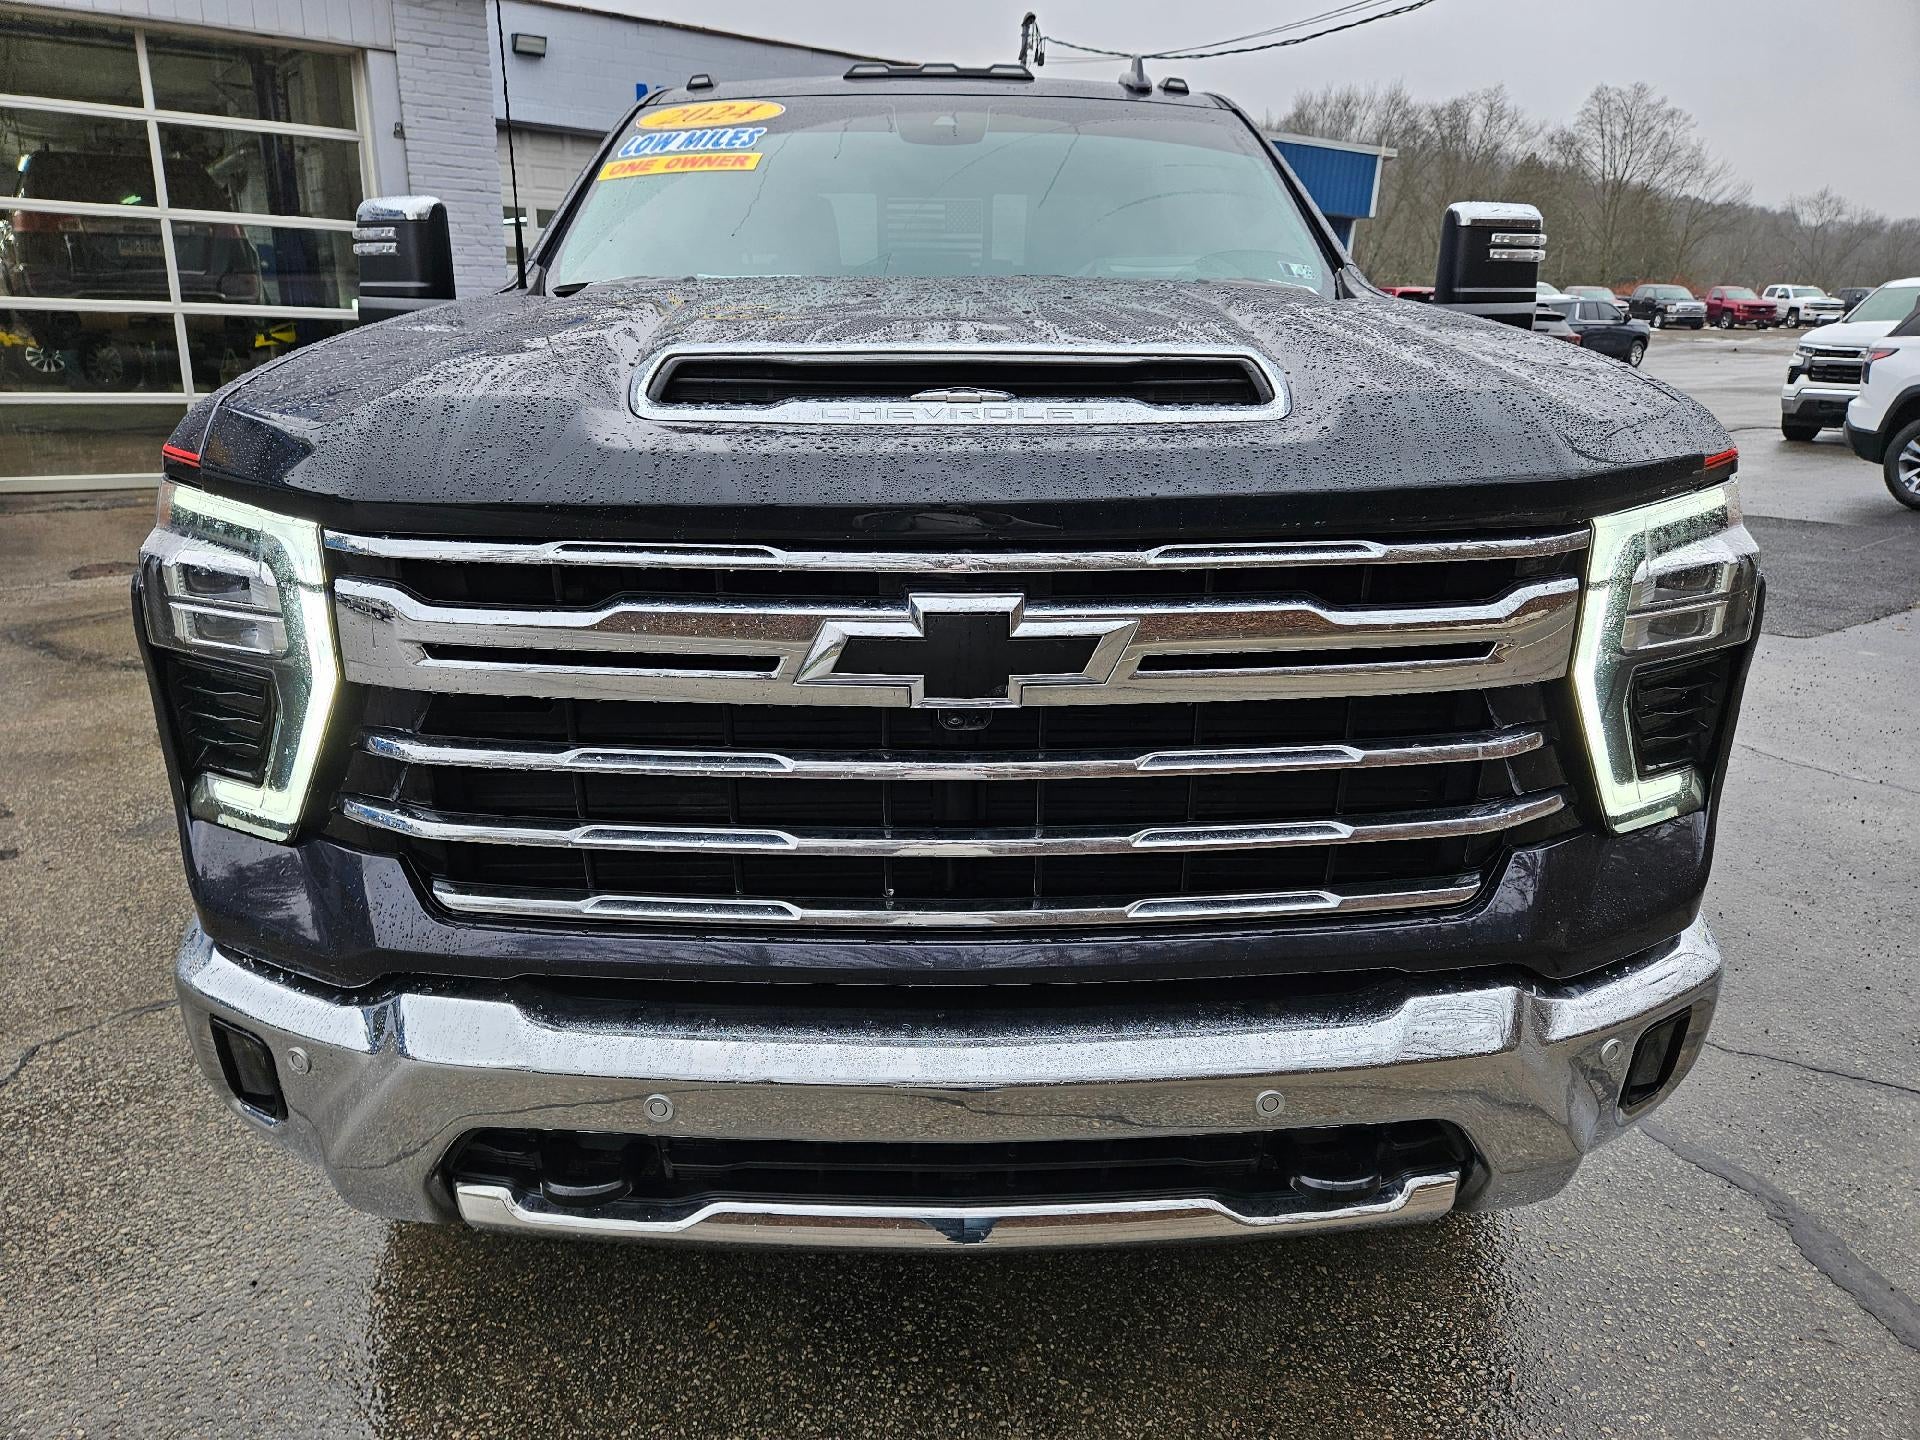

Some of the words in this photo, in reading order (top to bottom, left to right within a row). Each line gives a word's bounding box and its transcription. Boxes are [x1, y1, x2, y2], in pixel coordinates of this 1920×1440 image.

[656, 103, 764, 125] 2024
[619, 131, 679, 155] LOW
[677, 128, 766, 149] MILES
[609, 159, 659, 176] ONE
[664, 155, 748, 169] OWNER
[821, 407, 1104, 421] CHEVROLET
